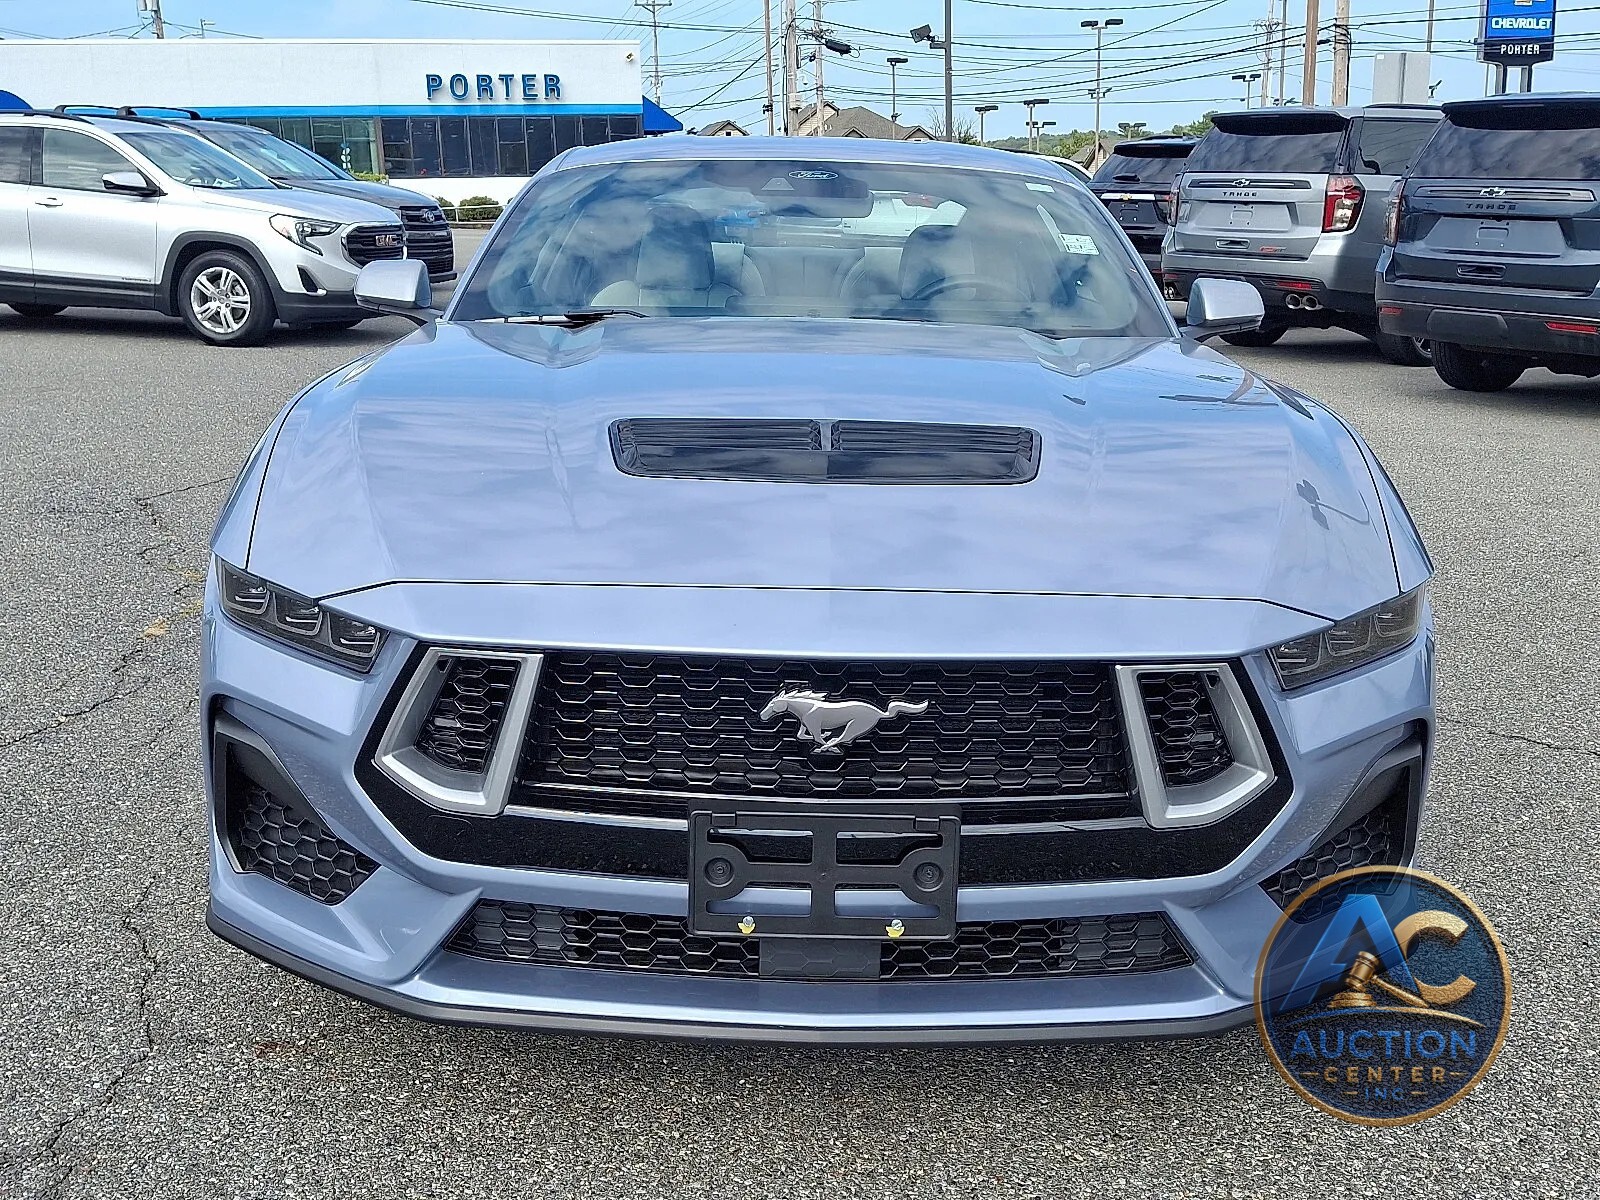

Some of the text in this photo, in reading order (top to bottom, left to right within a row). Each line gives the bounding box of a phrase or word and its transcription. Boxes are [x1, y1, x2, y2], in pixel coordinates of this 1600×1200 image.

[1491, 17, 1552, 29] CHEVROLET
[1500, 44, 1540, 55] PORTER
[426, 73, 562, 99] PORTER
[1466, 203, 1516, 211] TAHOE
